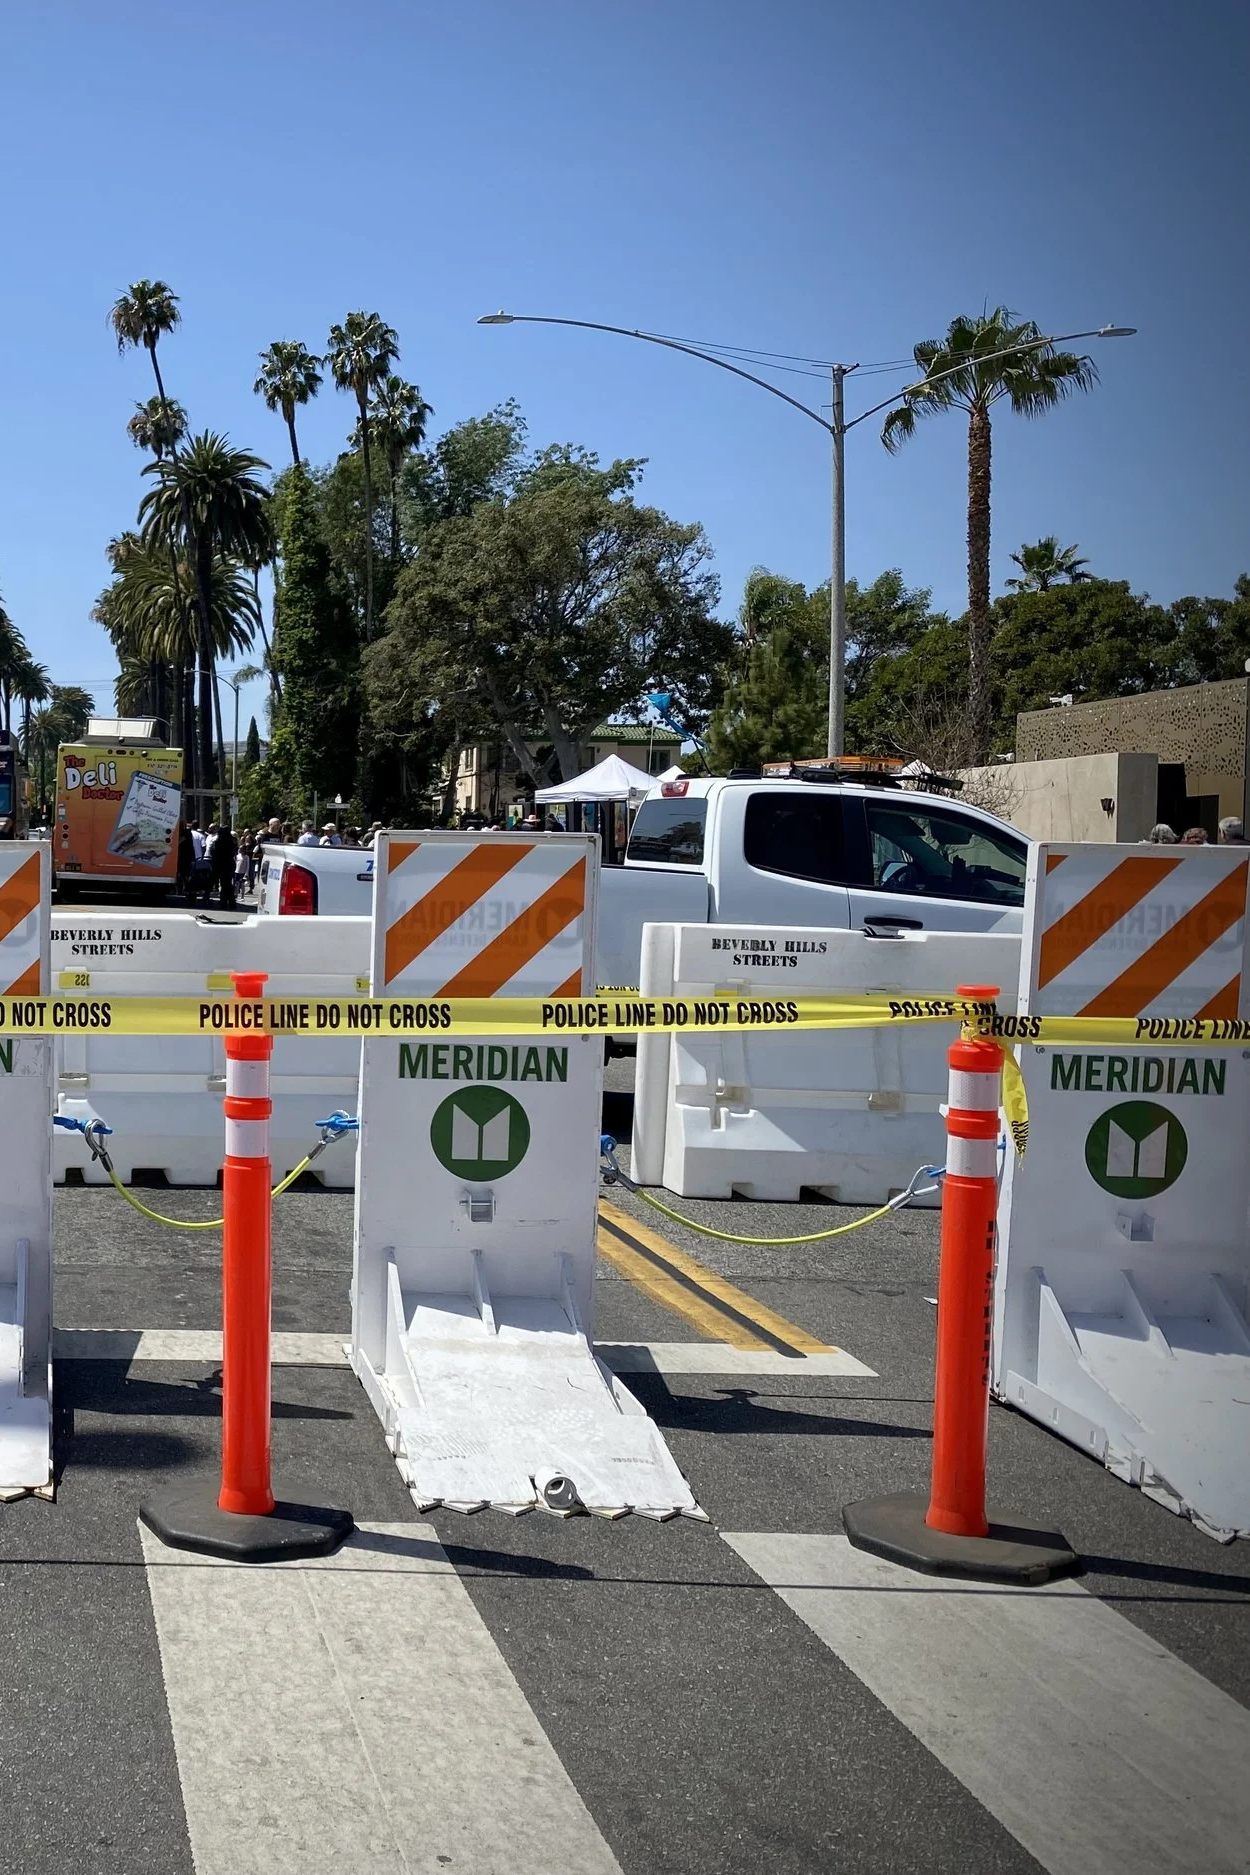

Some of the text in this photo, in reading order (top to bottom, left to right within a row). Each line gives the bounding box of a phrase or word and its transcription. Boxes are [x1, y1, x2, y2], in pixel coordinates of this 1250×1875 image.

[63, 755, 85, 768] The
[65, 762, 117, 790] Deli
[82, 786, 124, 801] Doctor
[50, 929, 162, 942] BEVERLY HILLS
[712, 938, 827, 953] BEVERLY HILLS
[72, 944, 134, 956] STREETS
[733, 954, 798, 967] STREETS
[13, 1002, 46, 1026] NOT
[53, 1003, 111, 1027] CROSS
[200, 1004, 451, 1028] POLICE LINE DO NOT CROSS
[543, 1002, 798, 1027] POLICE LINE DO NOT CROSS
[889, 1002, 956, 1018] POLICE
[978, 1015, 1042, 1037] CROSS
[1135, 1018, 1250, 1040] POLICE LINE
[399, 1043, 568, 1082] MERIDIAN
[1052, 1053, 1227, 1096] MERIDIAN
